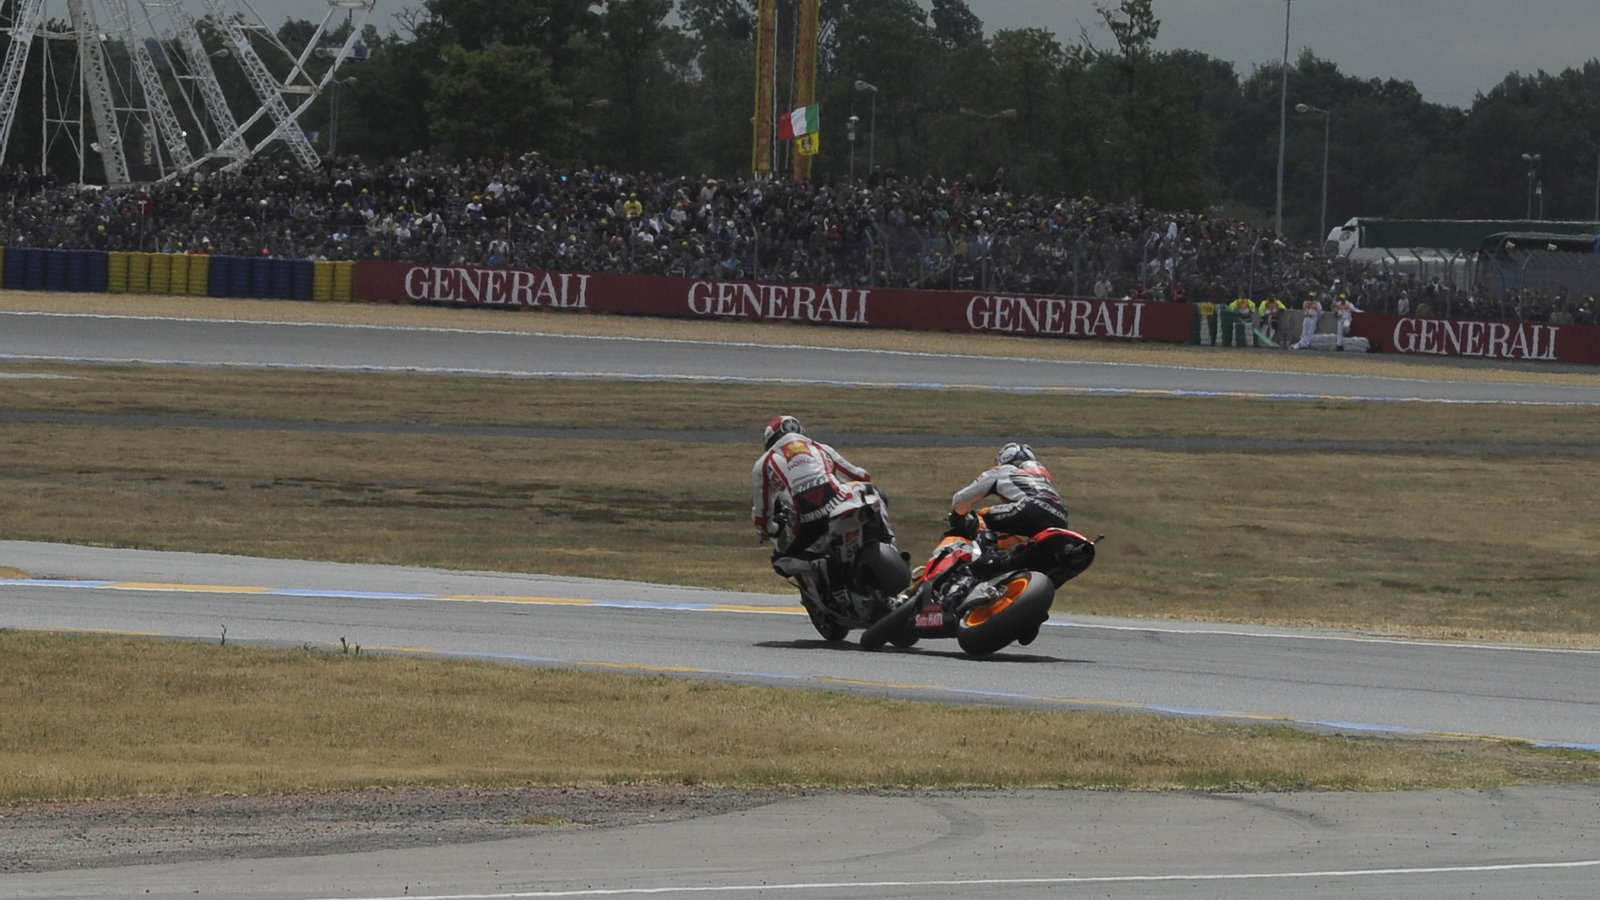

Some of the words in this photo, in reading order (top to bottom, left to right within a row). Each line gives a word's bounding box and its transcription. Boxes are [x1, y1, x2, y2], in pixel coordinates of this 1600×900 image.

[404, 266, 592, 308] GENERALI
[687, 280, 871, 324] GENERALI
[966, 294, 1143, 338] GENERALI
[1393, 317, 1559, 360] GENERALI
